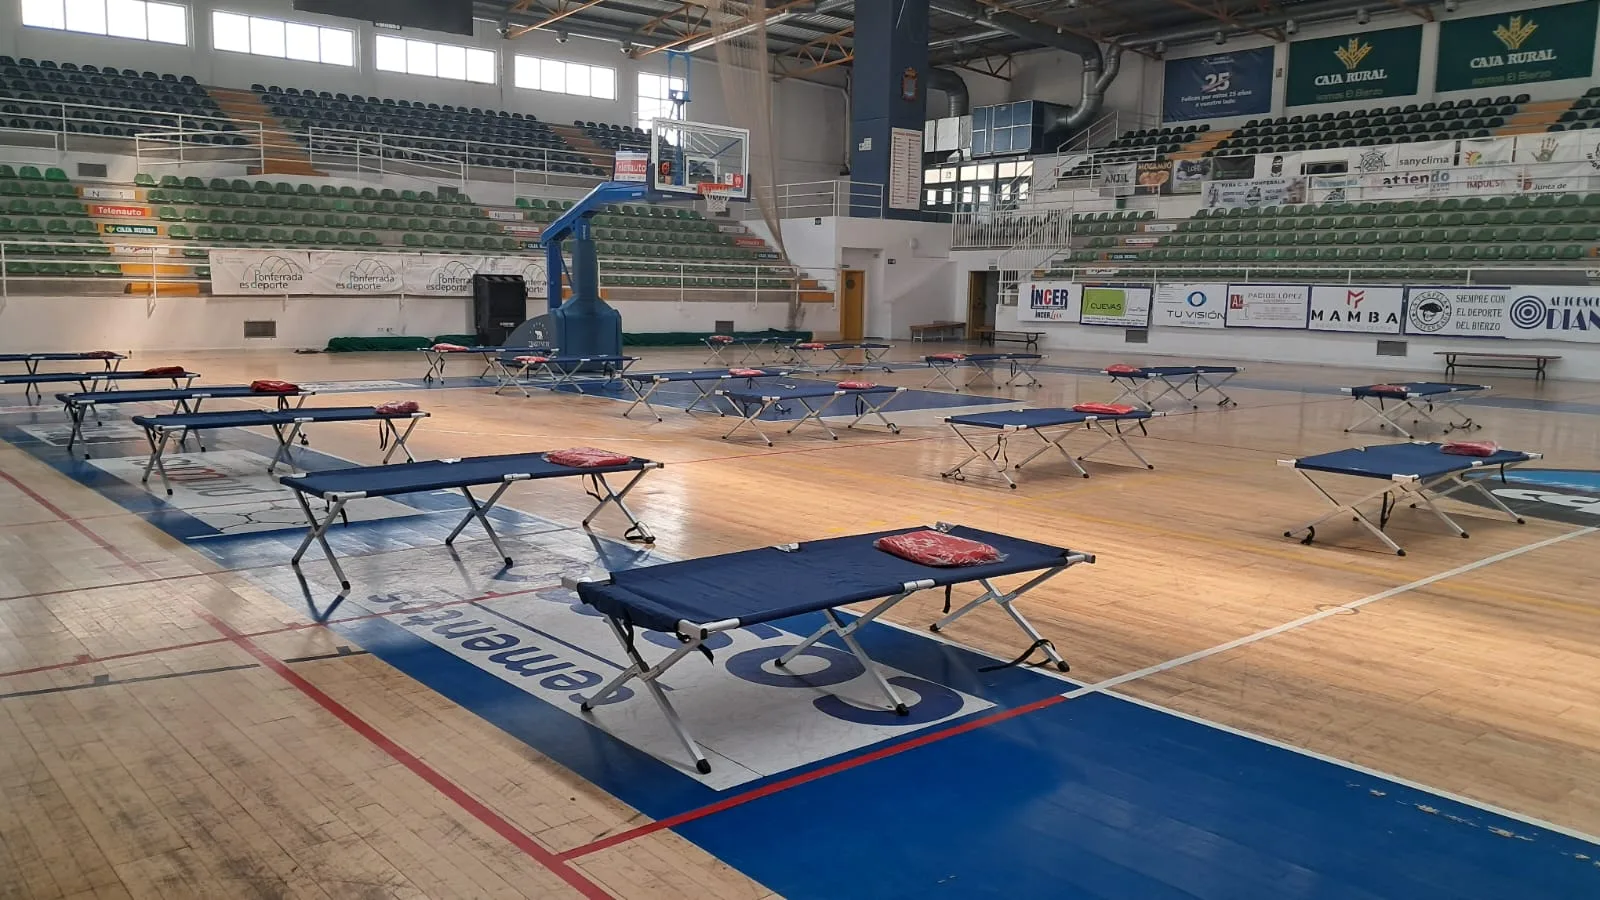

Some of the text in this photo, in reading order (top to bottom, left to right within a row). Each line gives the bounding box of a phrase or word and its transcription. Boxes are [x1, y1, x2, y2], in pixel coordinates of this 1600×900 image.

[1470, 49, 1558, 69] CAJA RURAL
[1314, 69, 1387, 86] CAJA RURAL
[1518, 70, 1552, 80] Bierzo
[1203, 72, 1231, 93] 25
[1399, 155, 1449, 167] sanyclima
[1383, 170, 1450, 185] atiendo
[98, 206, 142, 216] Telenauto
[254, 269, 303, 285] Ponferrada
[350, 271, 395, 286] Ponferrada
[250, 280, 289, 291] deporte
[346, 281, 382, 292] deporte
[1455, 294, 1490, 304] SIEMPRE
[1490, 295, 1506, 304] CON
[1090, 302, 1122, 311] CUEVAS
[1167, 310, 1226, 320] TU VISIÓN
[1310, 309, 1399, 325] MAMBA
[1456, 307, 1503, 318] EL DEPORTE
[1455, 321, 1501, 331] DEL BIERZO
